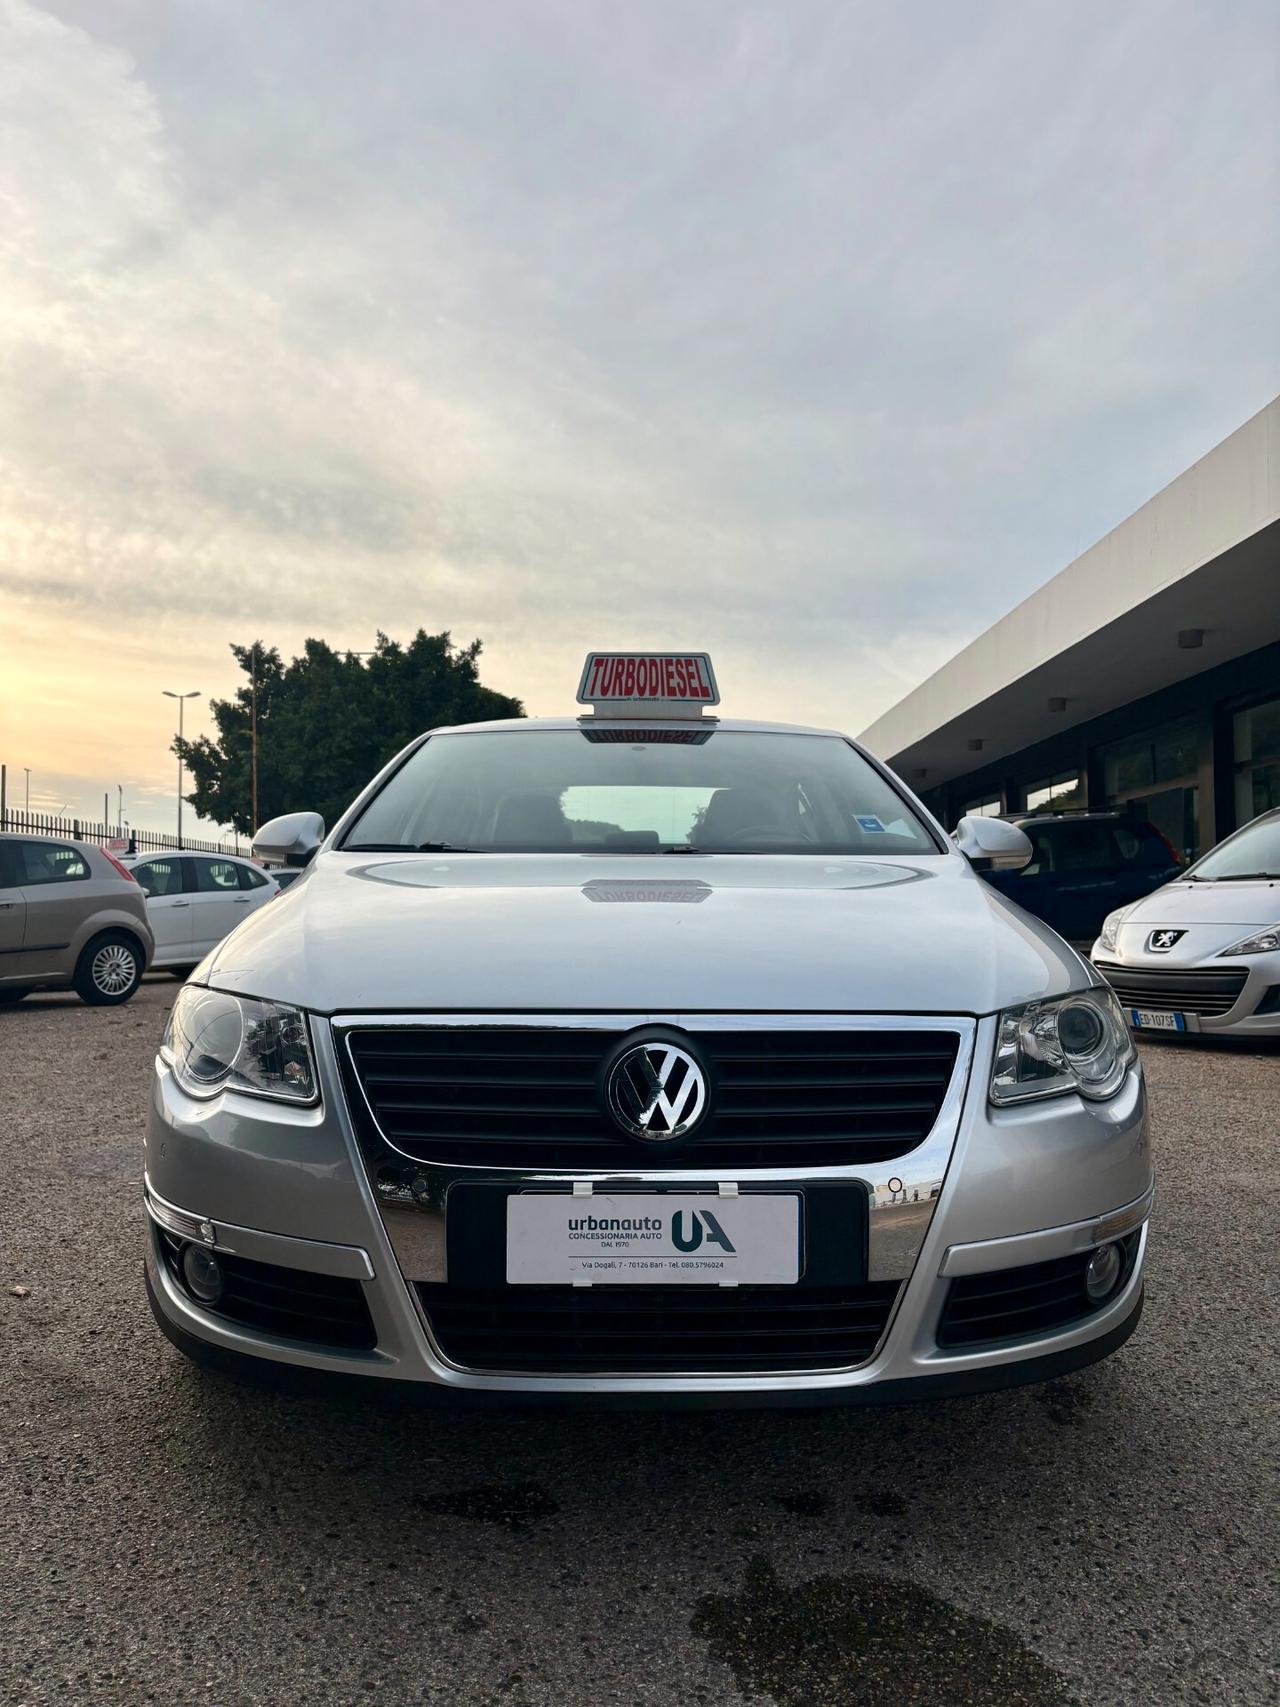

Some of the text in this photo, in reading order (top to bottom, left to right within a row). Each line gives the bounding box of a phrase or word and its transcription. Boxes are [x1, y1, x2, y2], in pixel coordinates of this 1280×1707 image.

[589, 658, 710, 697] TURBODIESEL
[568, 1215, 662, 1231] urbanauto
[568, 1232, 662, 1240] CONCESSIONARIA AUTO
[671, 1209, 736, 1253] UA
